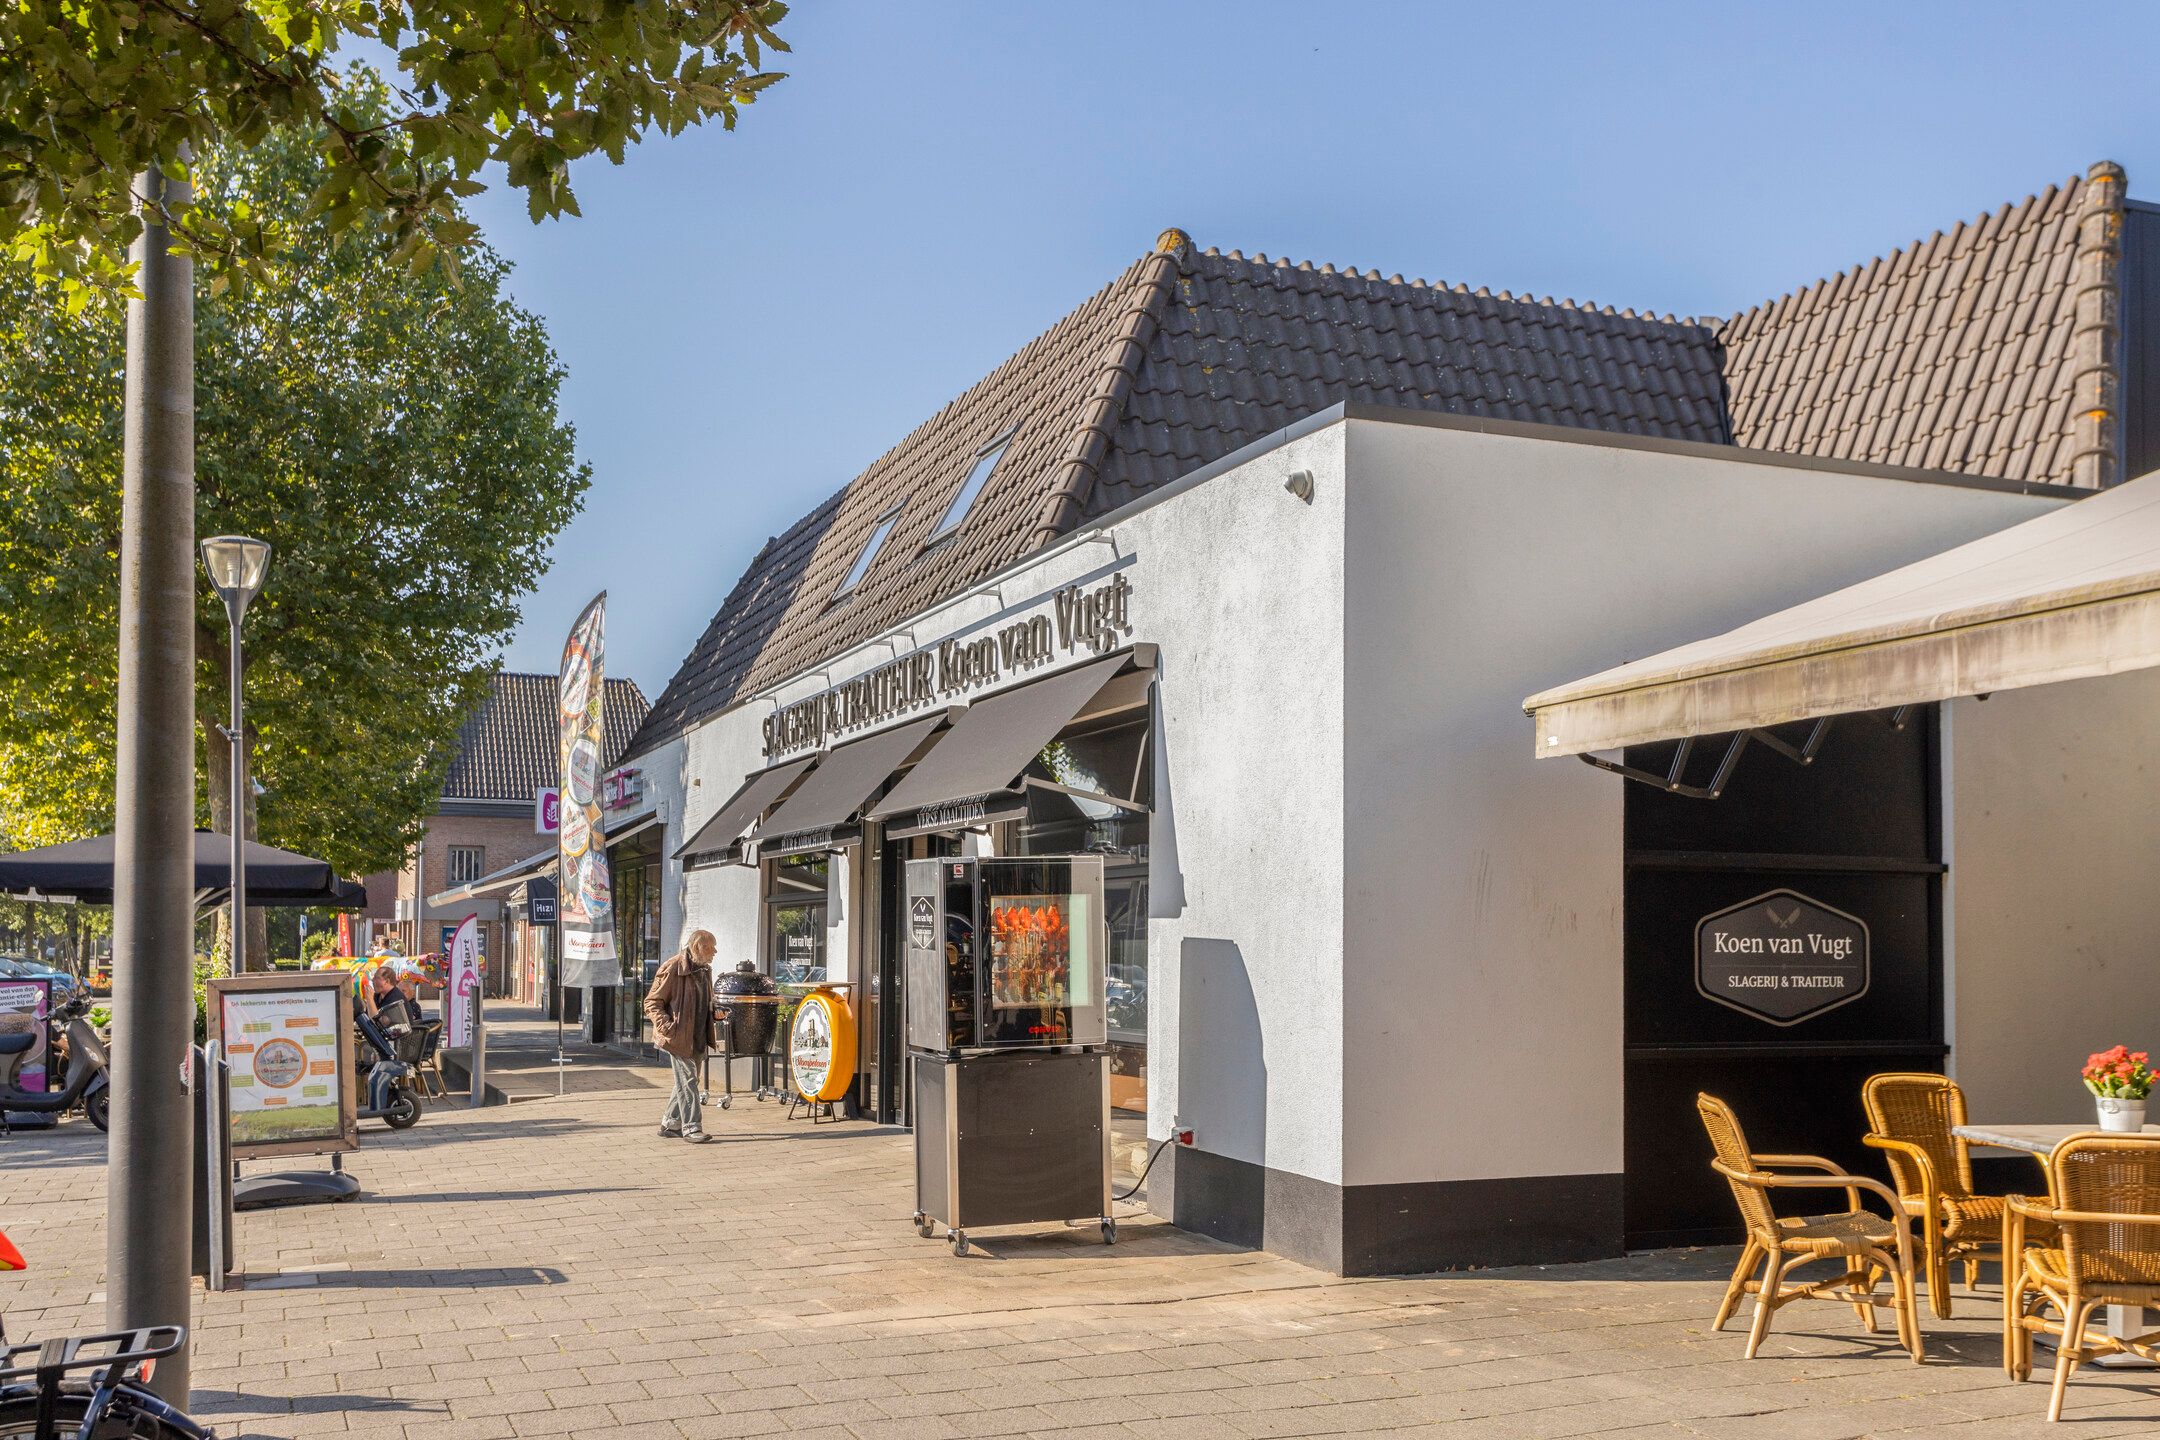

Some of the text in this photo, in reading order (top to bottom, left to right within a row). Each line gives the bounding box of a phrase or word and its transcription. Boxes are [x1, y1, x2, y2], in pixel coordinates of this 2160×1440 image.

[762, 572, 1130, 758] SLAGERIJ & TRAITEUR Koen van Vugt
[939, 802, 985, 826] MAALTIJDEN
[536, 903, 553, 913] HIZI
[463, 938, 473, 968] Bart
[1714, 932, 1853, 960] Koen van Vugt
[1728, 975, 1844, 989] SLAGERIJ & TRAITEUR
